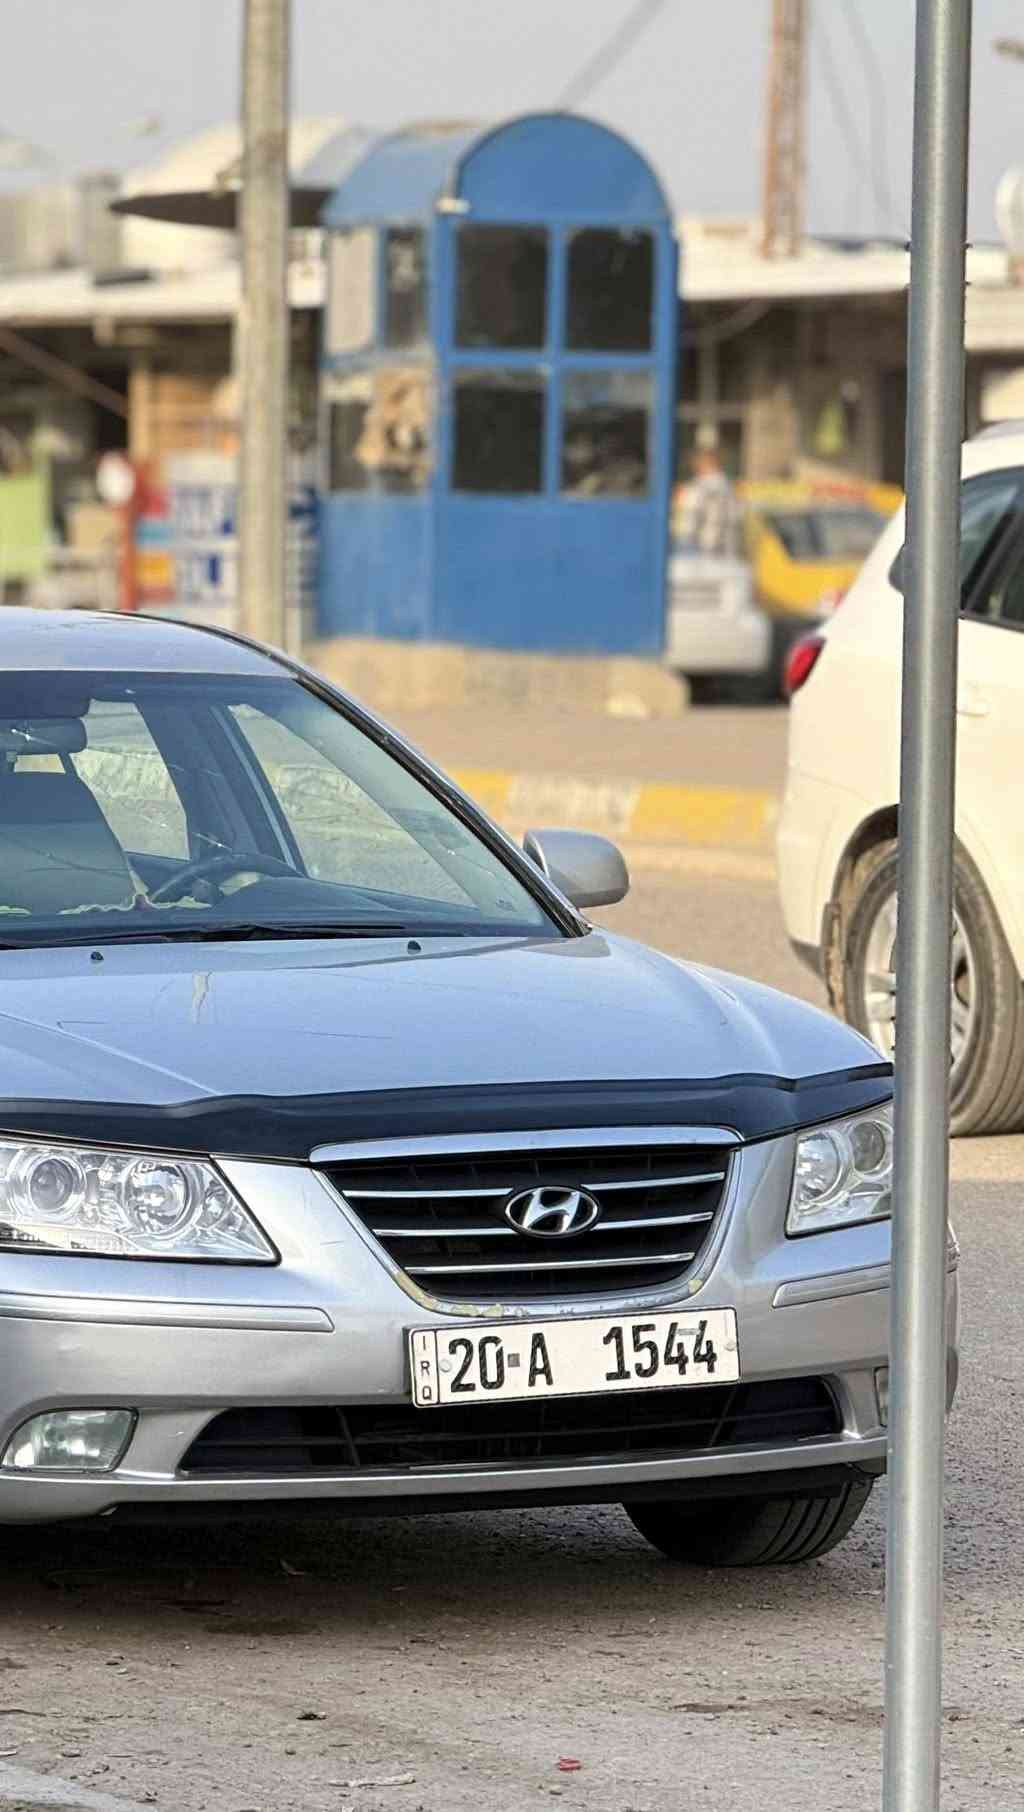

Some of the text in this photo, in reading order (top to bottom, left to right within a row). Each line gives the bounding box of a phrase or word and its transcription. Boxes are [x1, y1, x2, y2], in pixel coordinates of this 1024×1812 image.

[448, 1319, 718, 1393] 20 A 1544
